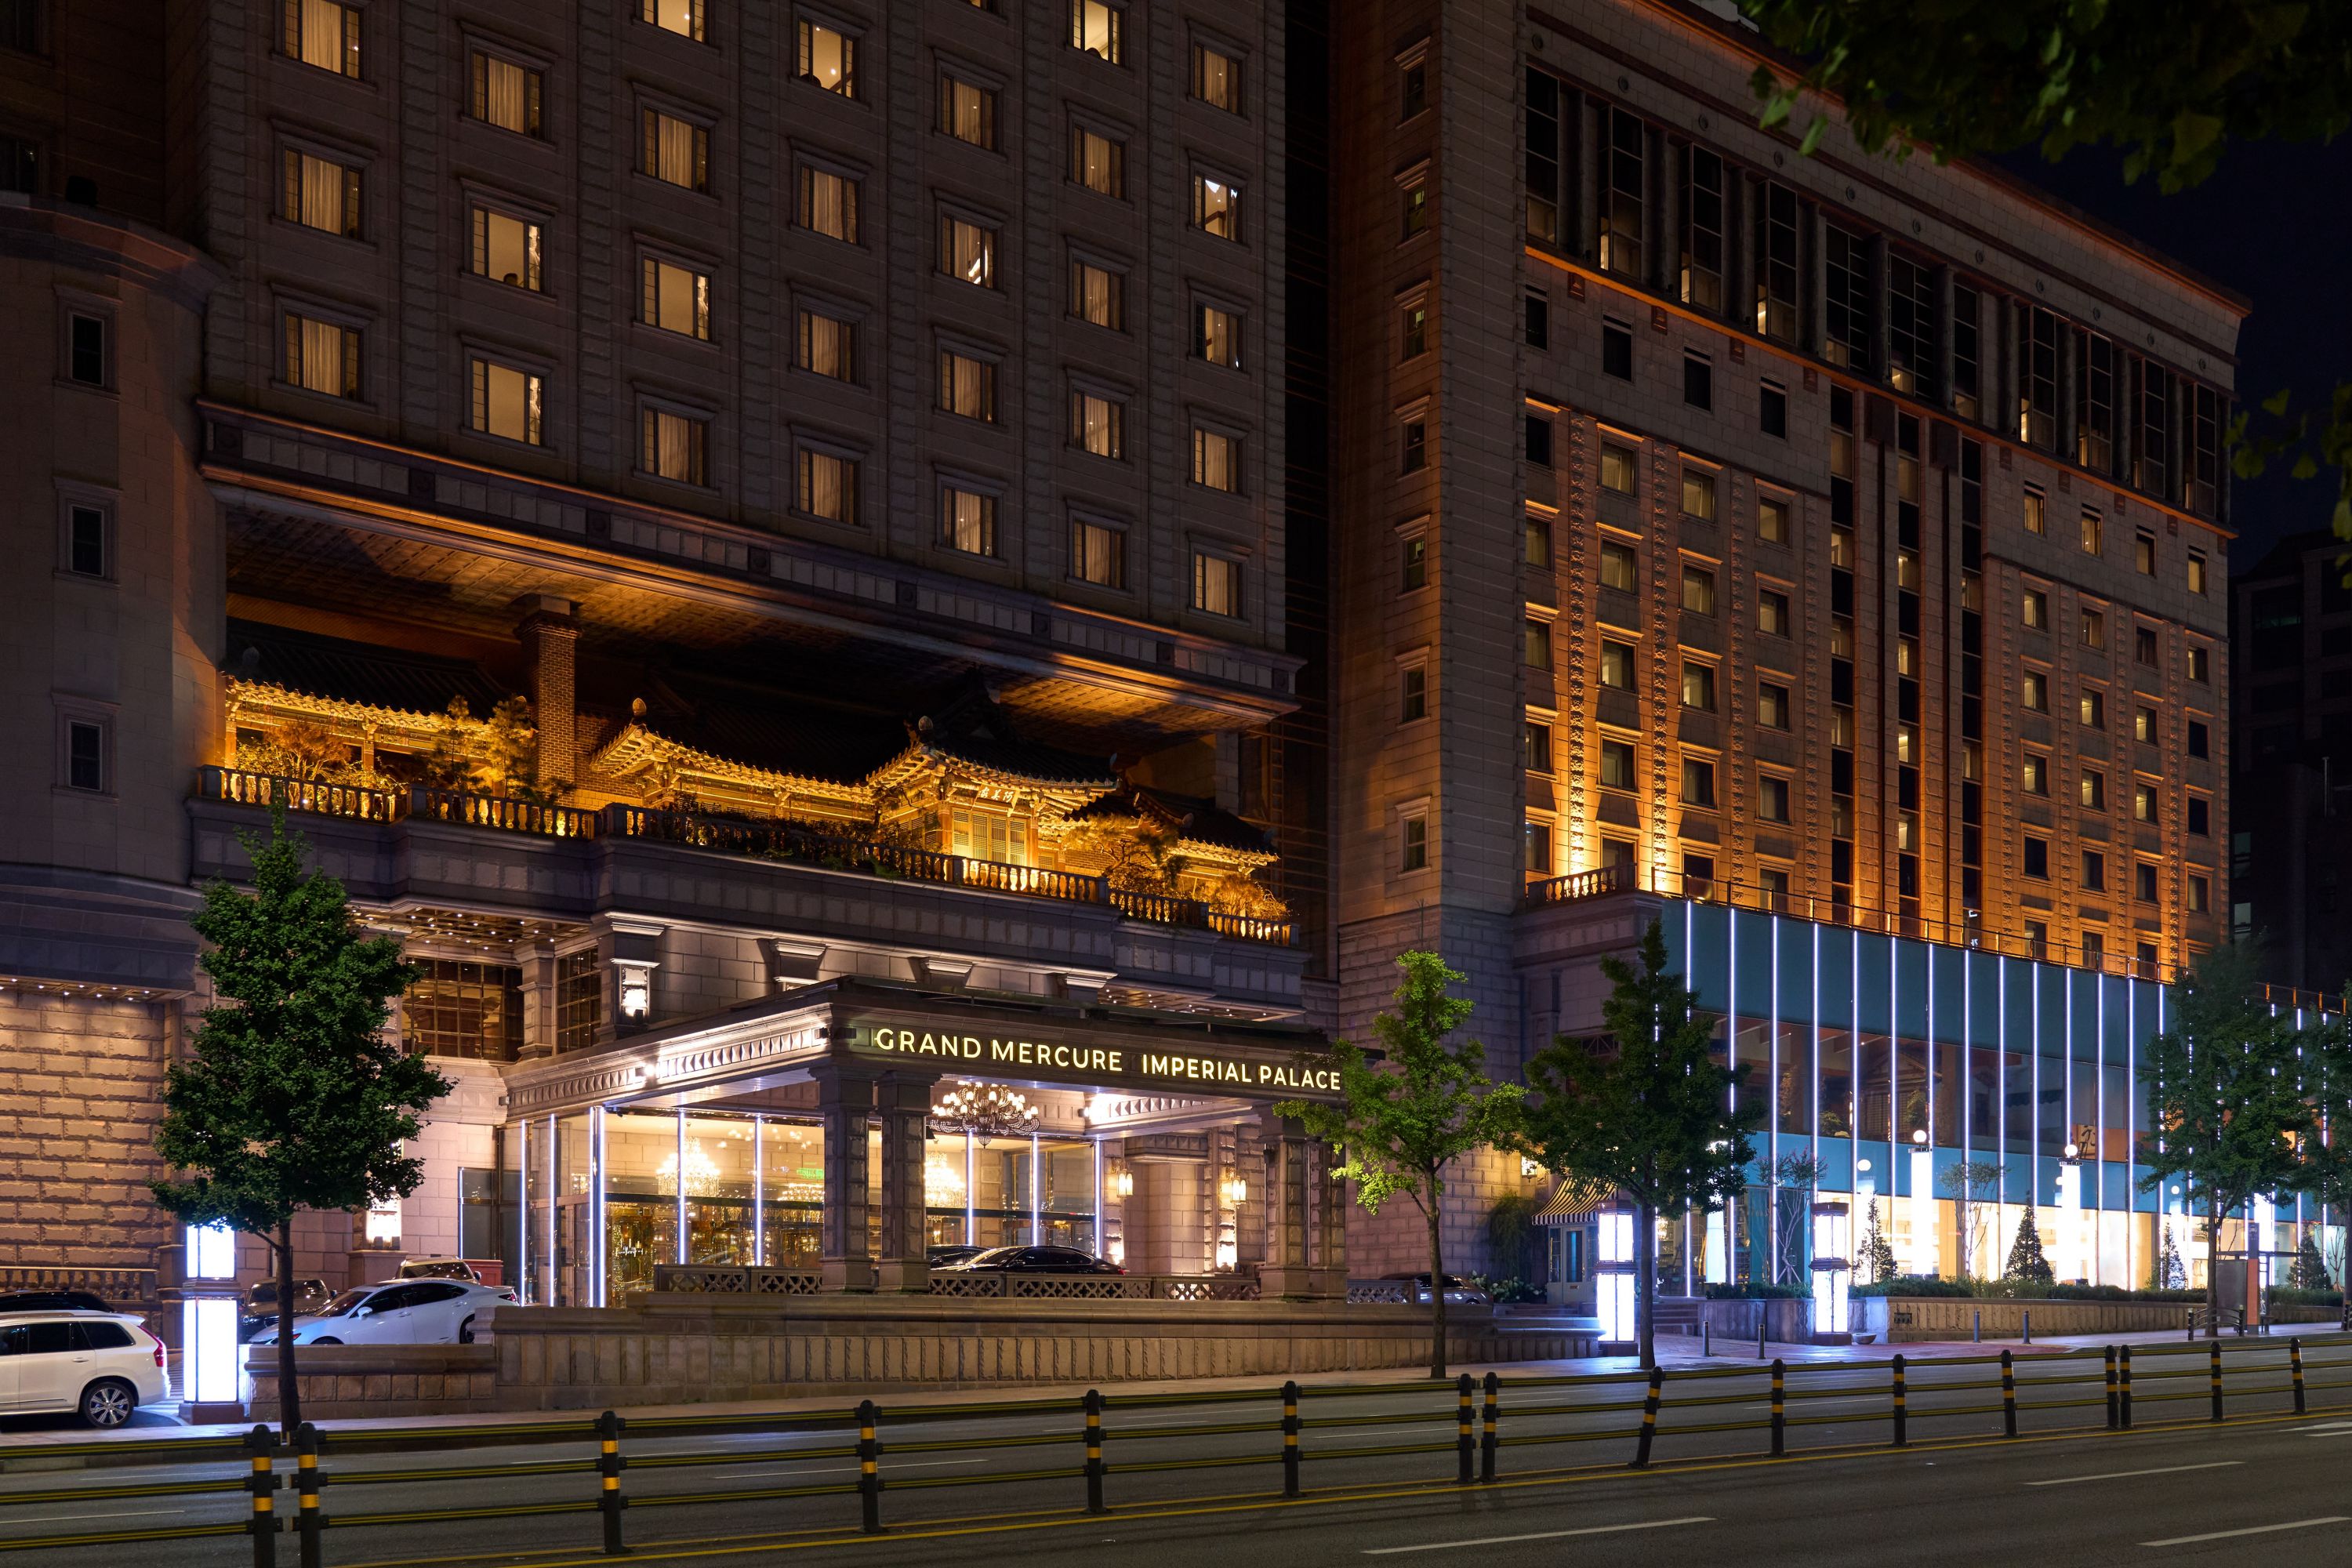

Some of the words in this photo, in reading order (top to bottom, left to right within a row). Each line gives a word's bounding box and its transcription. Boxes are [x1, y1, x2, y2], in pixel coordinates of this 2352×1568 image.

[875, 1028, 982, 1058] GRAND
[992, 1040, 1123, 1072] MERCURE
[1143, 1054, 1252, 1083] IMPERIAL
[1259, 1065, 1341, 1091] PALACE
